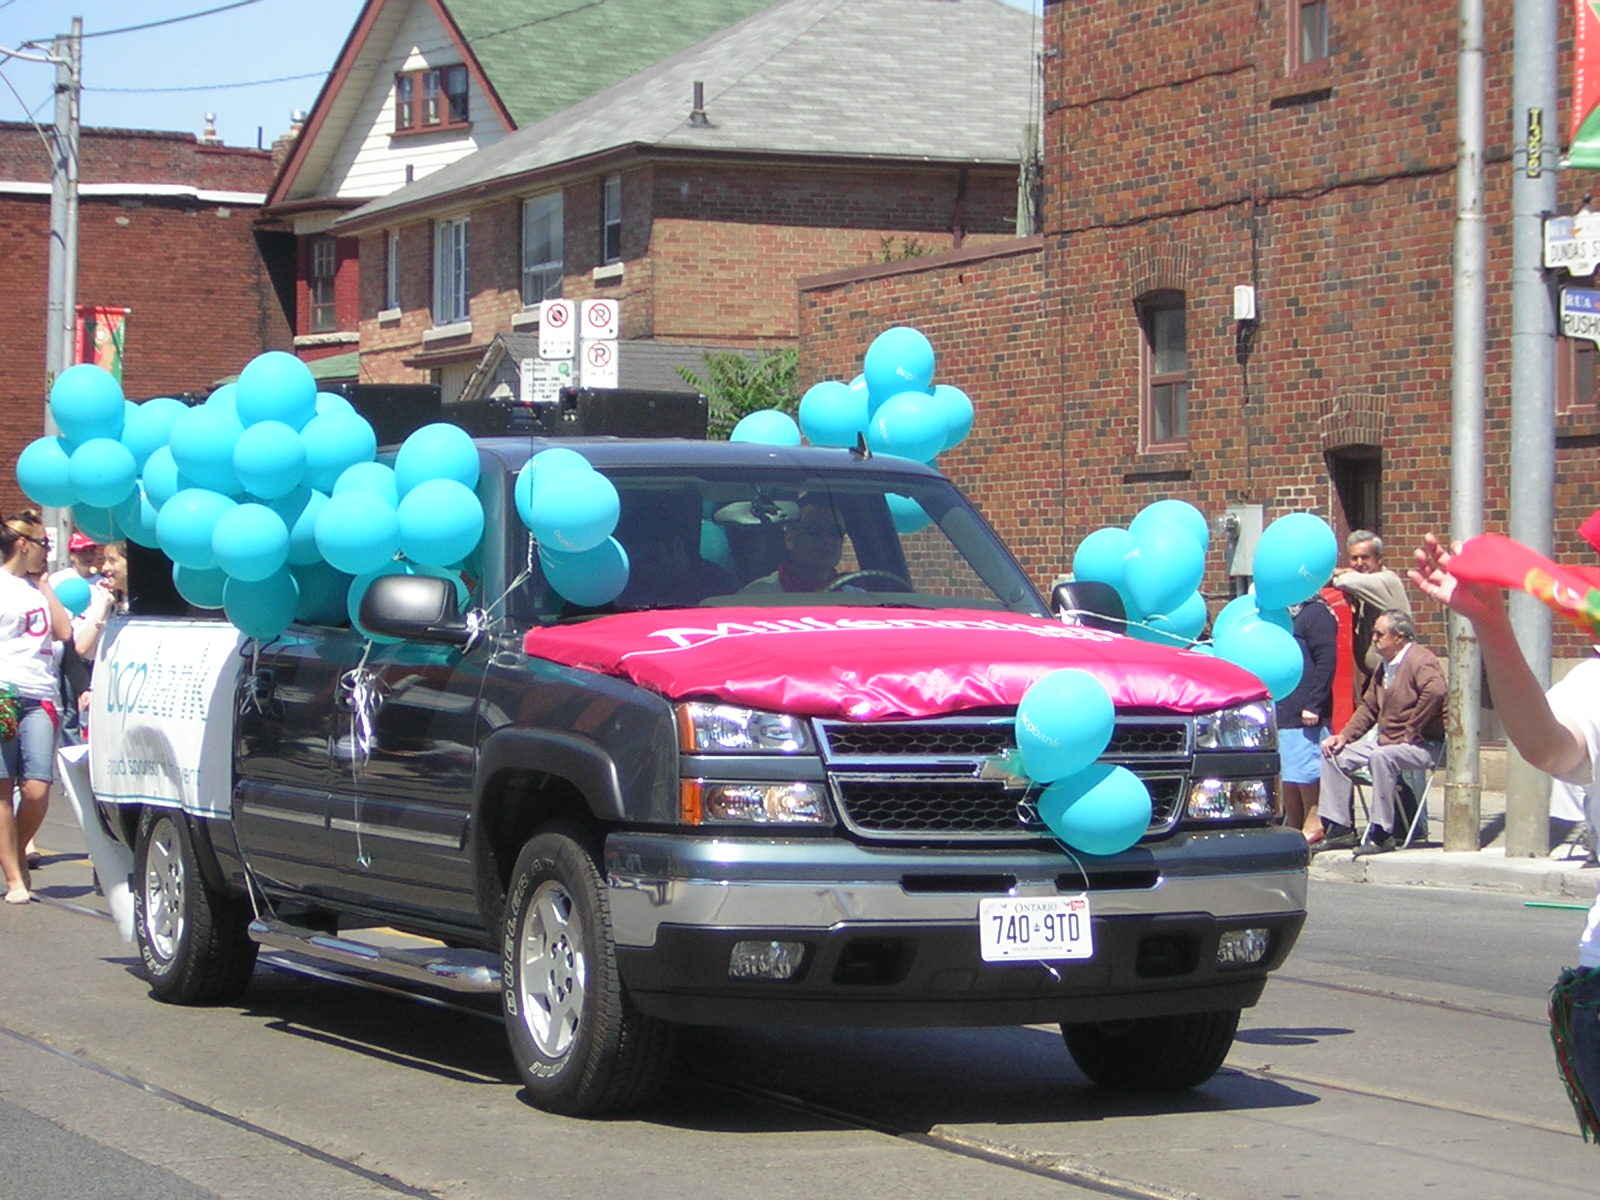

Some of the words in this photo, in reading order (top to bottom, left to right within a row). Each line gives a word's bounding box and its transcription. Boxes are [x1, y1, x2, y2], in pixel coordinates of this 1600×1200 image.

[1550, 241, 1586, 263] DUNDAS
[1566, 293, 1592, 309] RUA
[1014, 902, 1058, 913] ONTARIO
